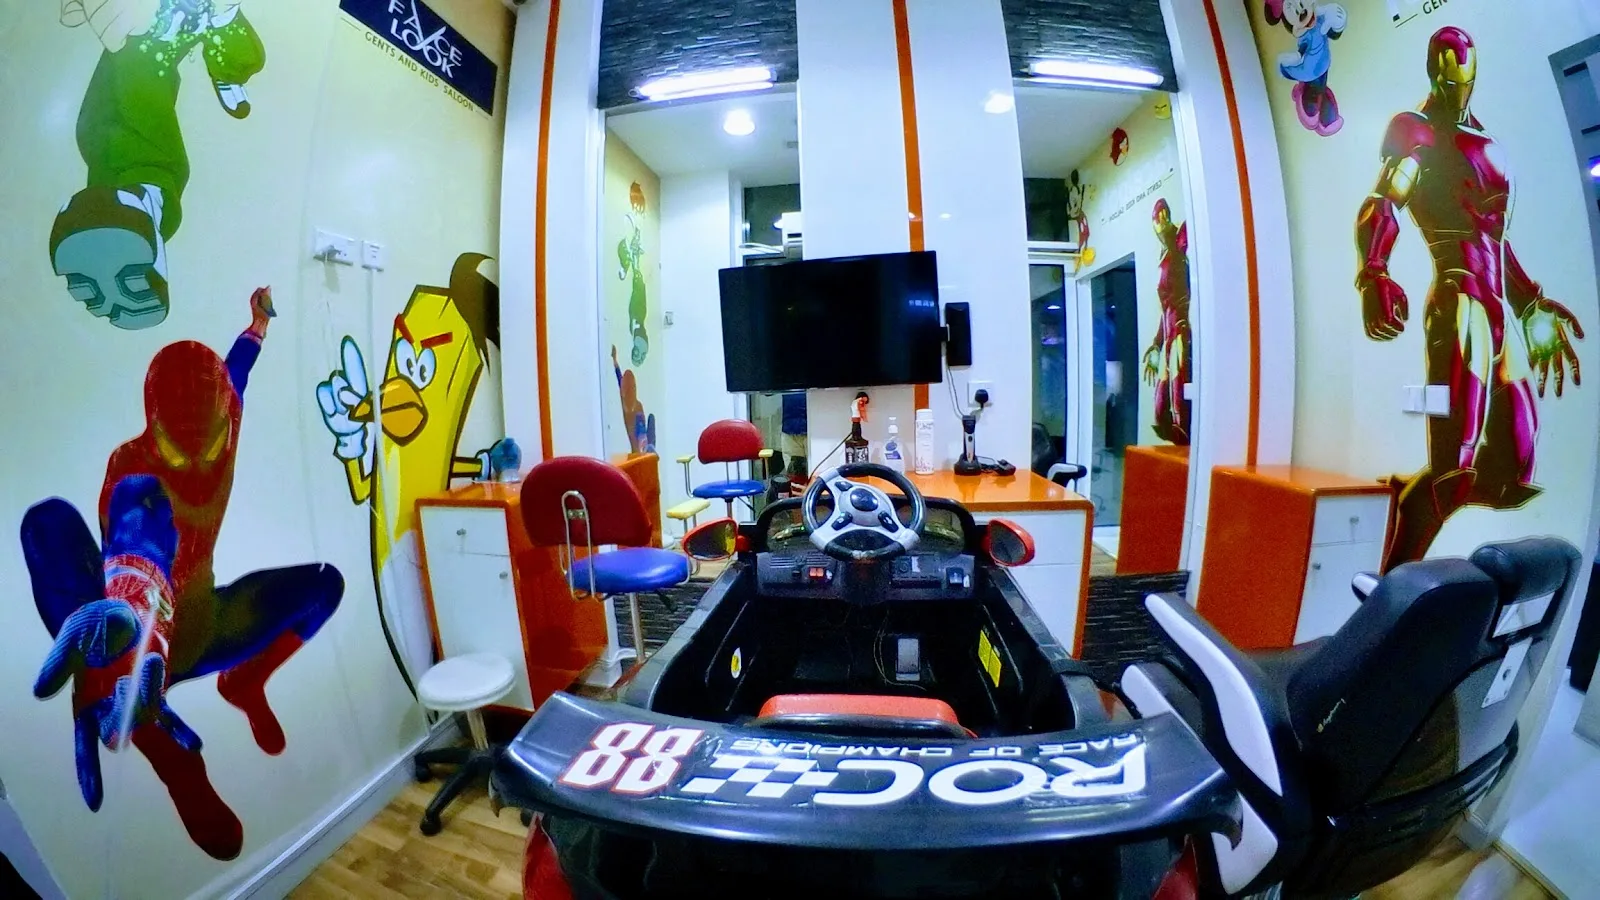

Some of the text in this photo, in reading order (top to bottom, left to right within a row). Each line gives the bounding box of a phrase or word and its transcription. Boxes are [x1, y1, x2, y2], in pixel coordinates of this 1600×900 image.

[365, 31, 474, 112] GENTS AND KIDS SALOON
[390, 18, 454, 79] LOOK
[557, 720, 704, 796] 88
[730, 733, 1137, 757] RACE OF CHAMPIONS
